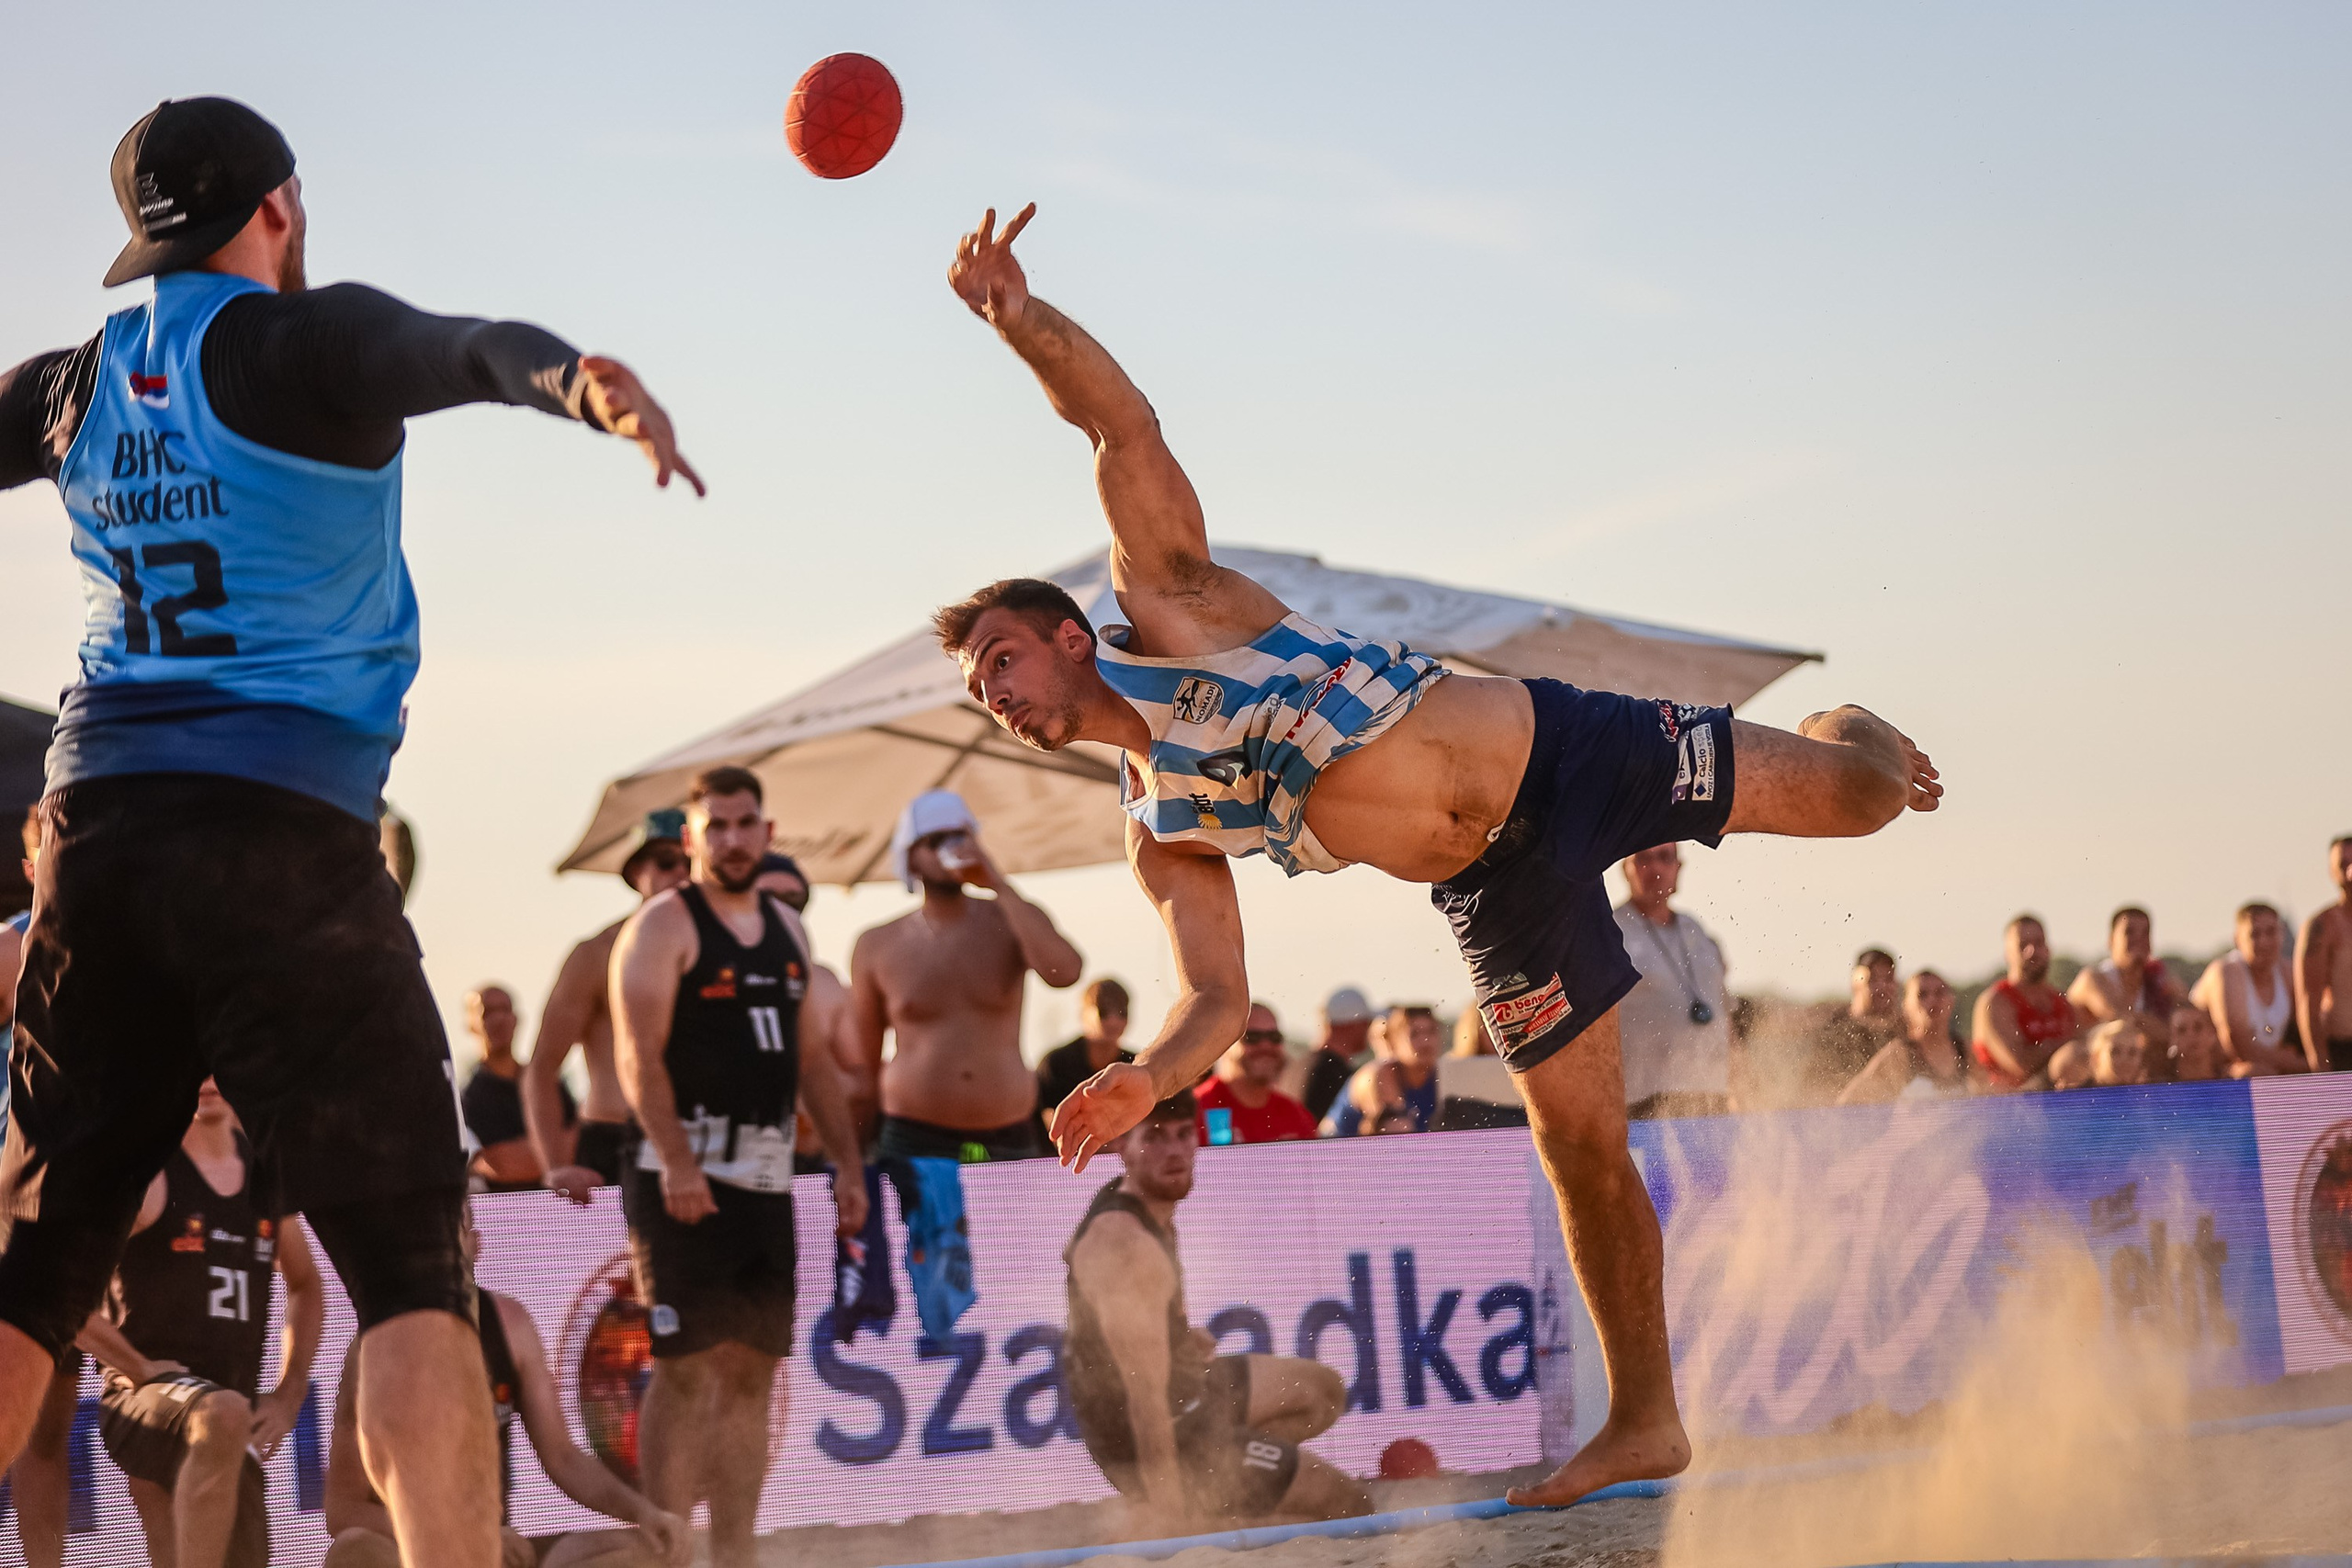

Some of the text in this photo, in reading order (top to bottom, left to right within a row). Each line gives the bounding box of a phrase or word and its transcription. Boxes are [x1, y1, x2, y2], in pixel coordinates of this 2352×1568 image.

[112, 427, 186, 480] BHC
[91, 475, 230, 531] student
[103, 539, 238, 657] 12
[1195, 685, 1216, 722] NOMADI
[1698, 748, 1707, 778] calcio
[747, 1006, 785, 1051] 11
[209, 1265, 249, 1321] 21
[812, 1247, 1538, 1465] Szadka
[1242, 1440, 1282, 1470] 18
